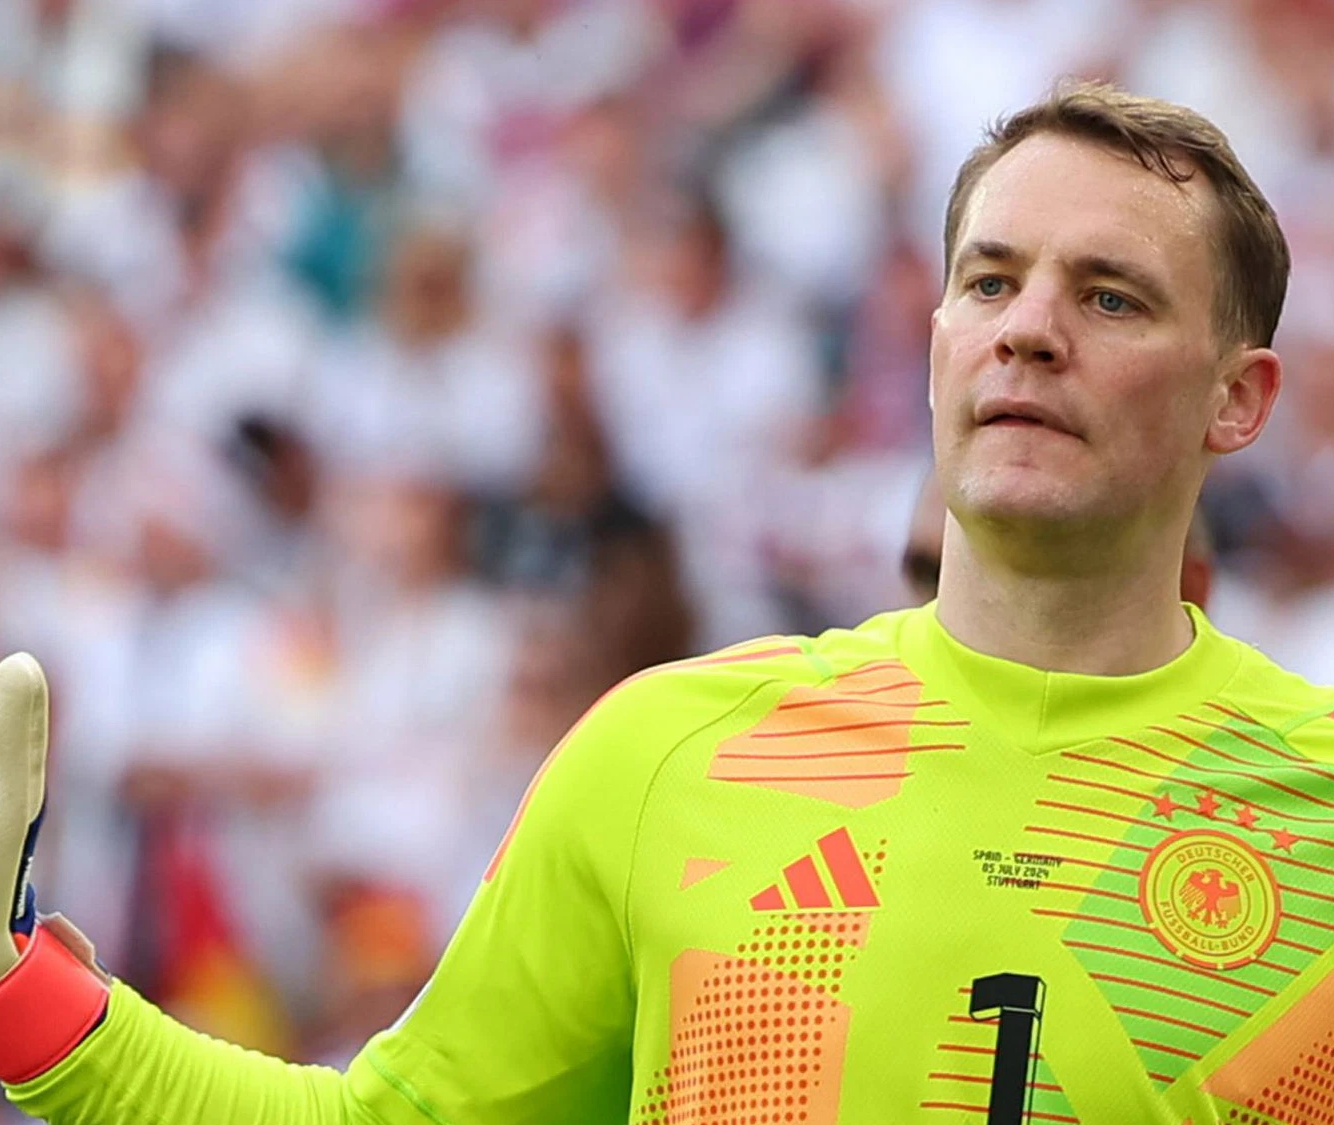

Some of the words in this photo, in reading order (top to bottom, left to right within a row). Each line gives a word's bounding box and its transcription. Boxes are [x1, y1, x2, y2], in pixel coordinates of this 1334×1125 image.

[972, 849, 1002, 862] SPAIN
[1013, 852, 1062, 867] GERMANY
[1175, 846, 1256, 884] DEUTSCHER
[982, 862, 995, 874] 05
[998, 864, 1021, 876] JULY
[1023, 866, 1050, 879] 2024
[986, 875, 1042, 890] STUTTGART
[1160, 900, 1256, 951] FUSSBALL-BUND
